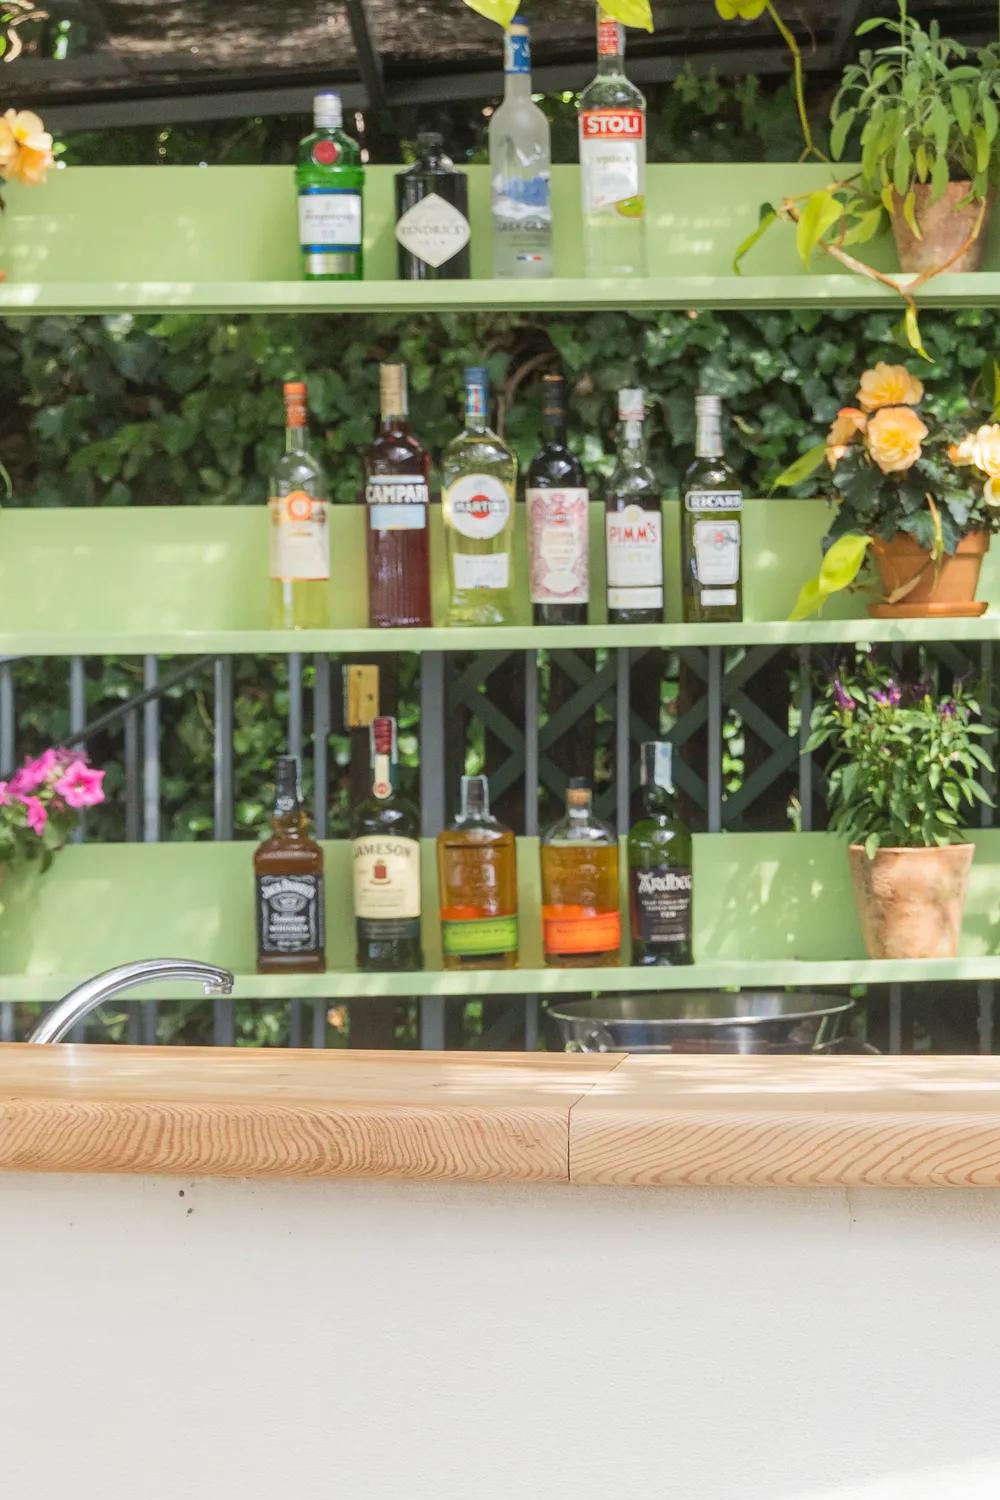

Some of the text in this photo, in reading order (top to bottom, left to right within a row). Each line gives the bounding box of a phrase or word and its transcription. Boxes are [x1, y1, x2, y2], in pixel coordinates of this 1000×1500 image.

[587, 116, 640, 134] STOLI
[366, 485, 429, 504] CAMPARI
[690, 495, 741, 508] RICARD
[453, 501, 508, 514] MARTINI
[609, 522, 658, 545] PIMM'S
[353, 844, 412, 858] JAMESON
